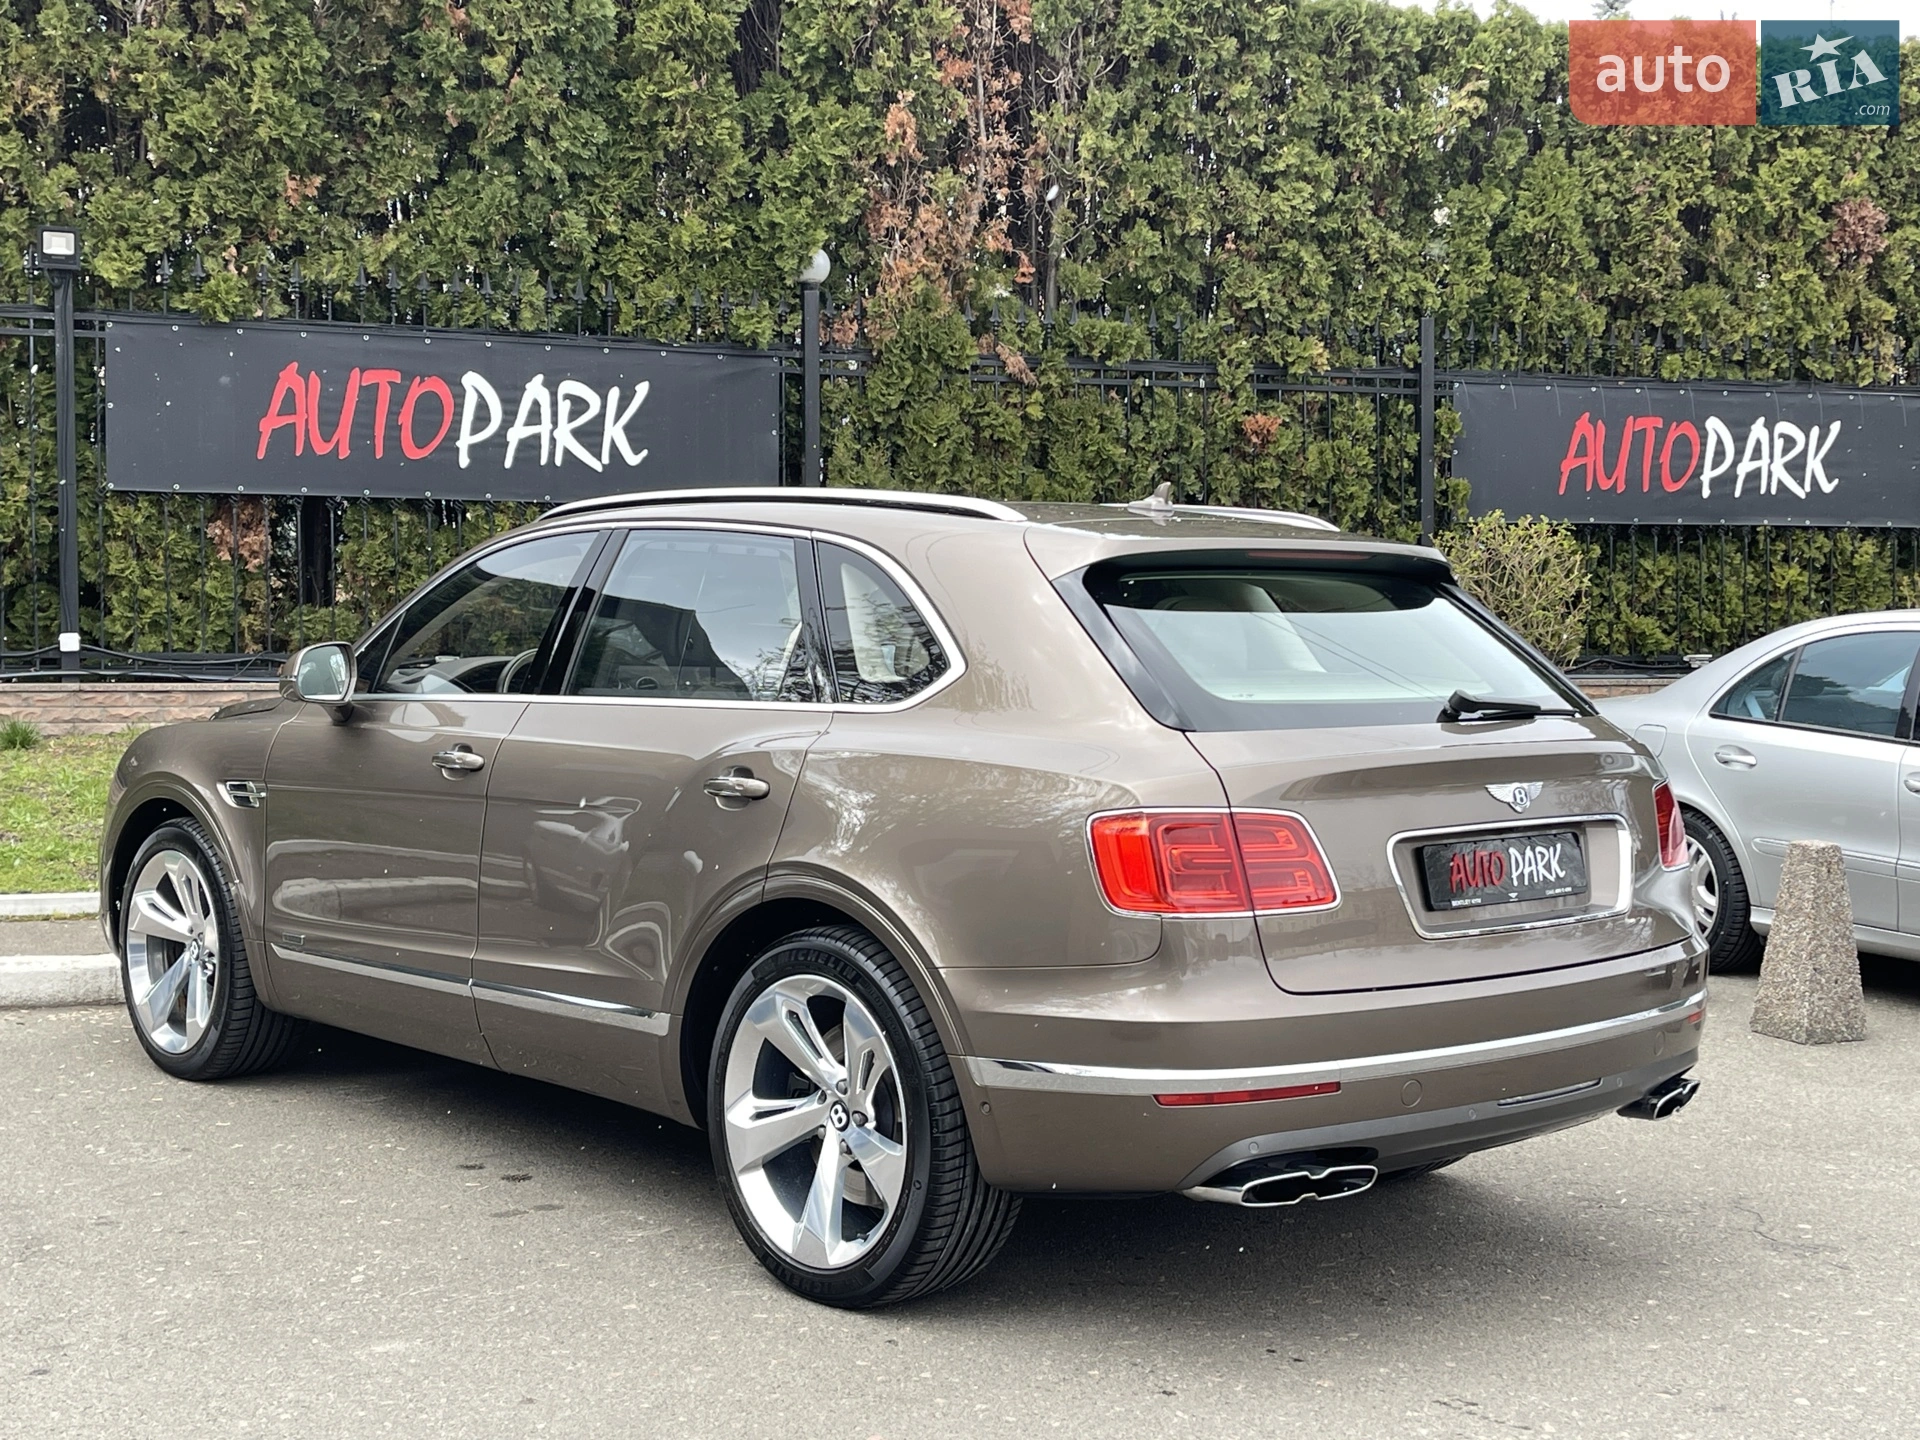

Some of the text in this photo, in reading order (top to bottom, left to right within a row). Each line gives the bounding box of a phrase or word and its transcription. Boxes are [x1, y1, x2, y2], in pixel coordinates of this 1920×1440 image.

[1449, 843, 1566, 894] AUTO PARK
[777, 948, 858, 980] MICHELIN
